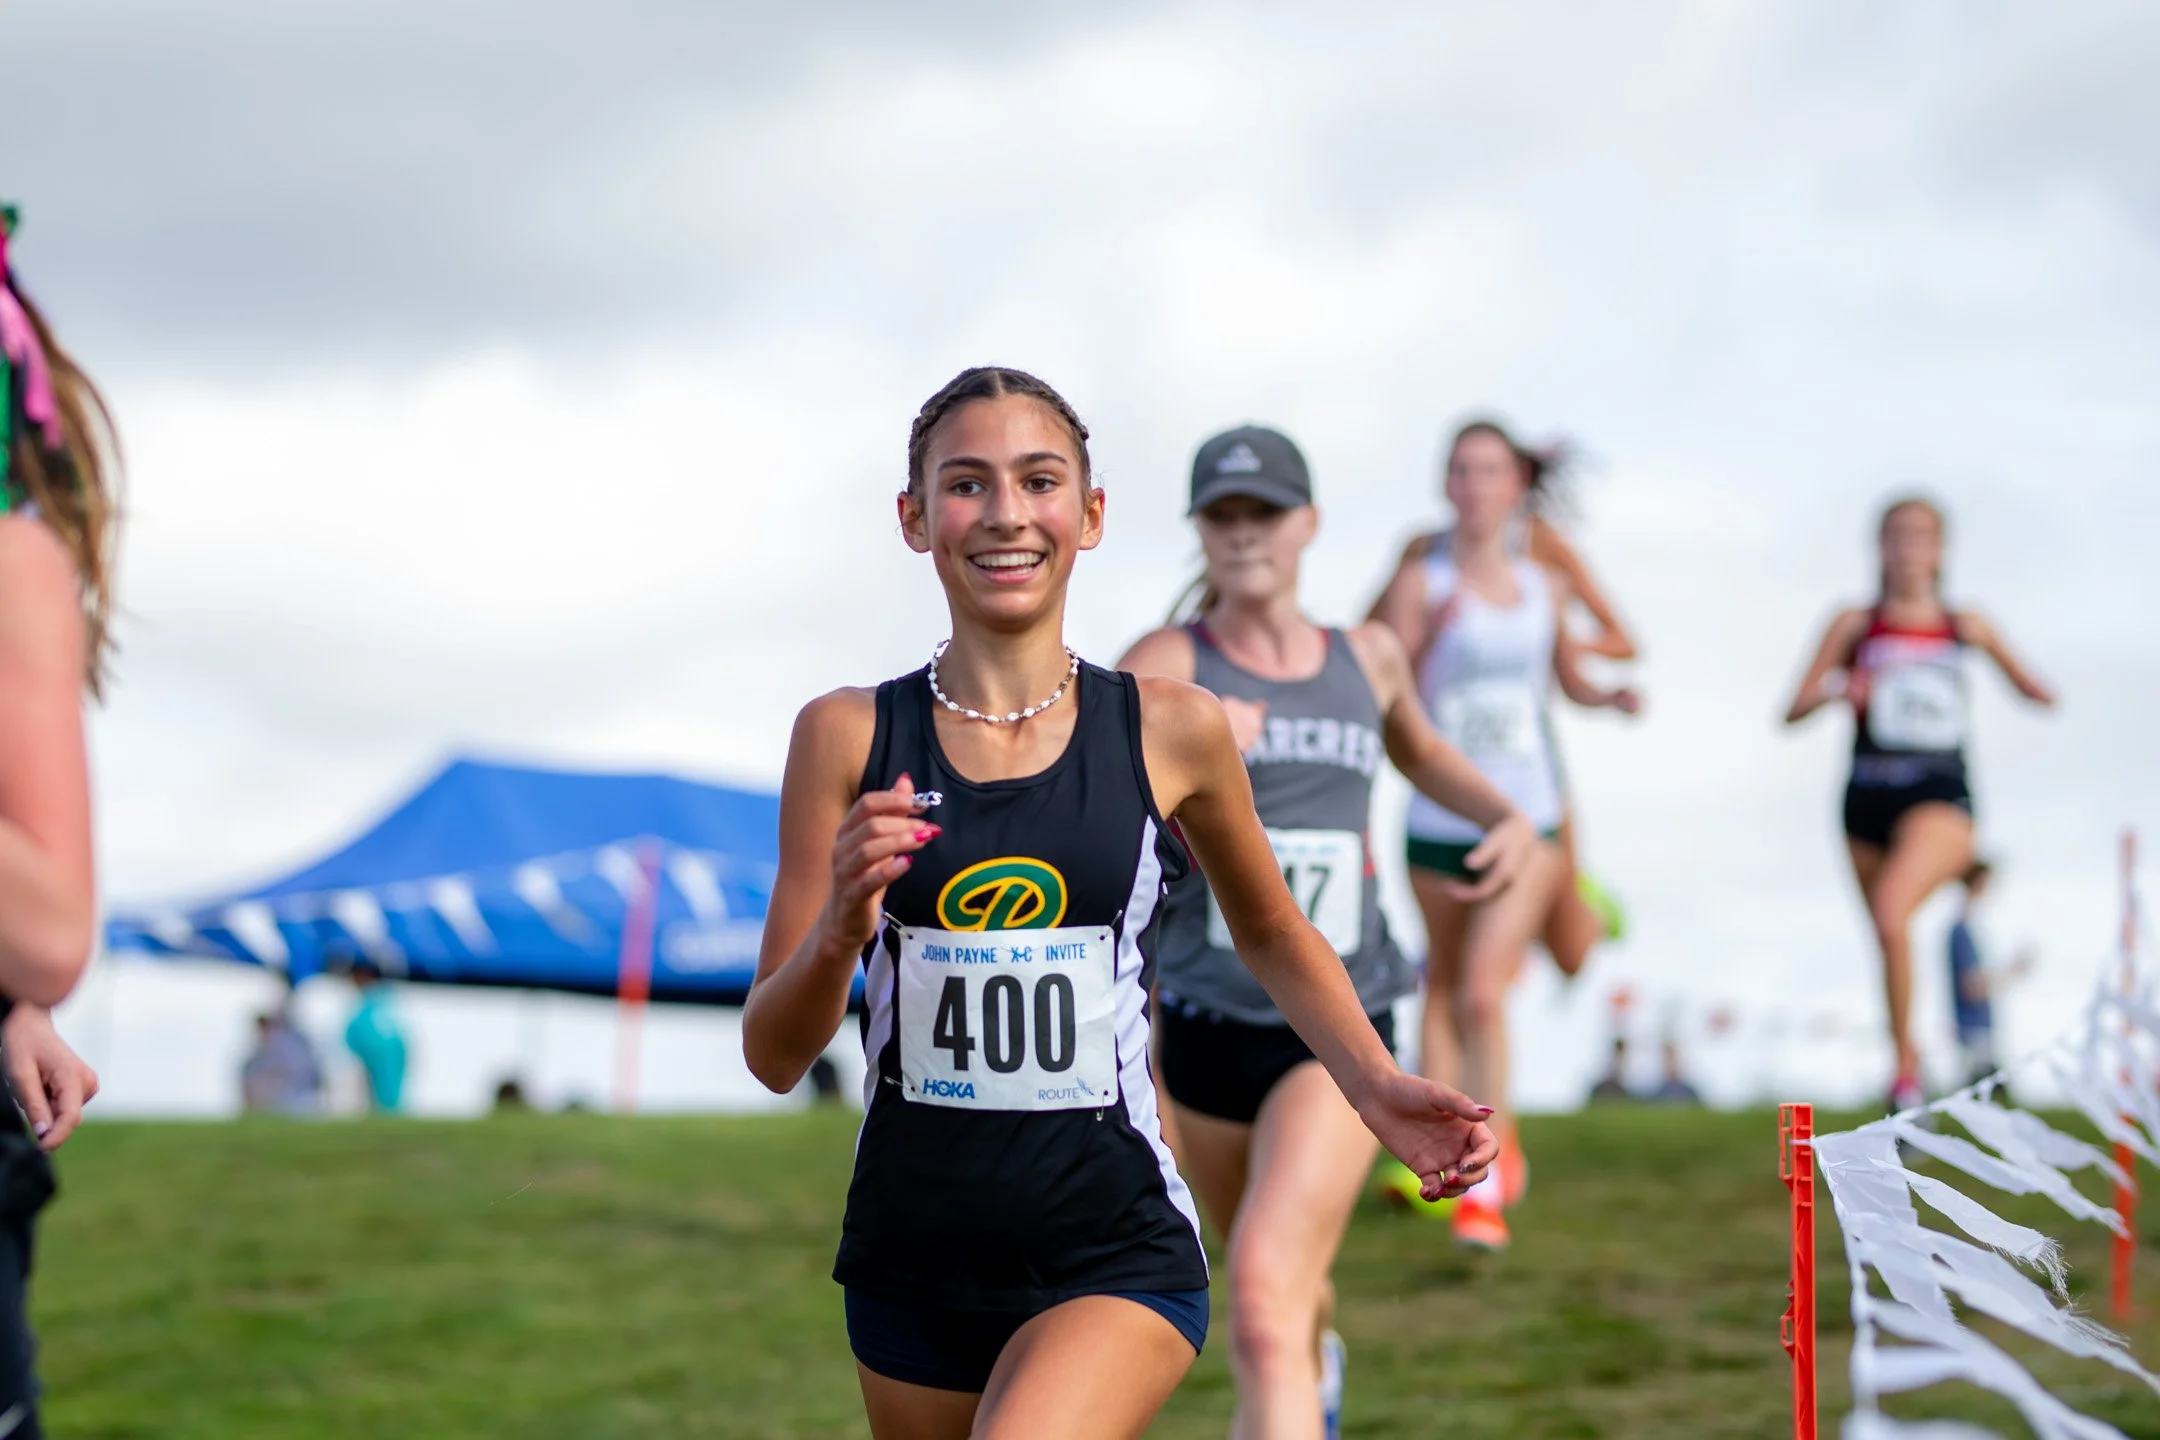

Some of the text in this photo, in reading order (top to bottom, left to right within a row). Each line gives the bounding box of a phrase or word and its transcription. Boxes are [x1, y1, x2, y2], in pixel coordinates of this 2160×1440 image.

[921, 943, 951, 963] JOHN
[955, 947, 998, 964] PAYNE
[1046, 943, 1087, 961] INVITE
[933, 973, 1077, 1073] 400
[923, 1078, 1080, 1100] HOKA ROUTE
